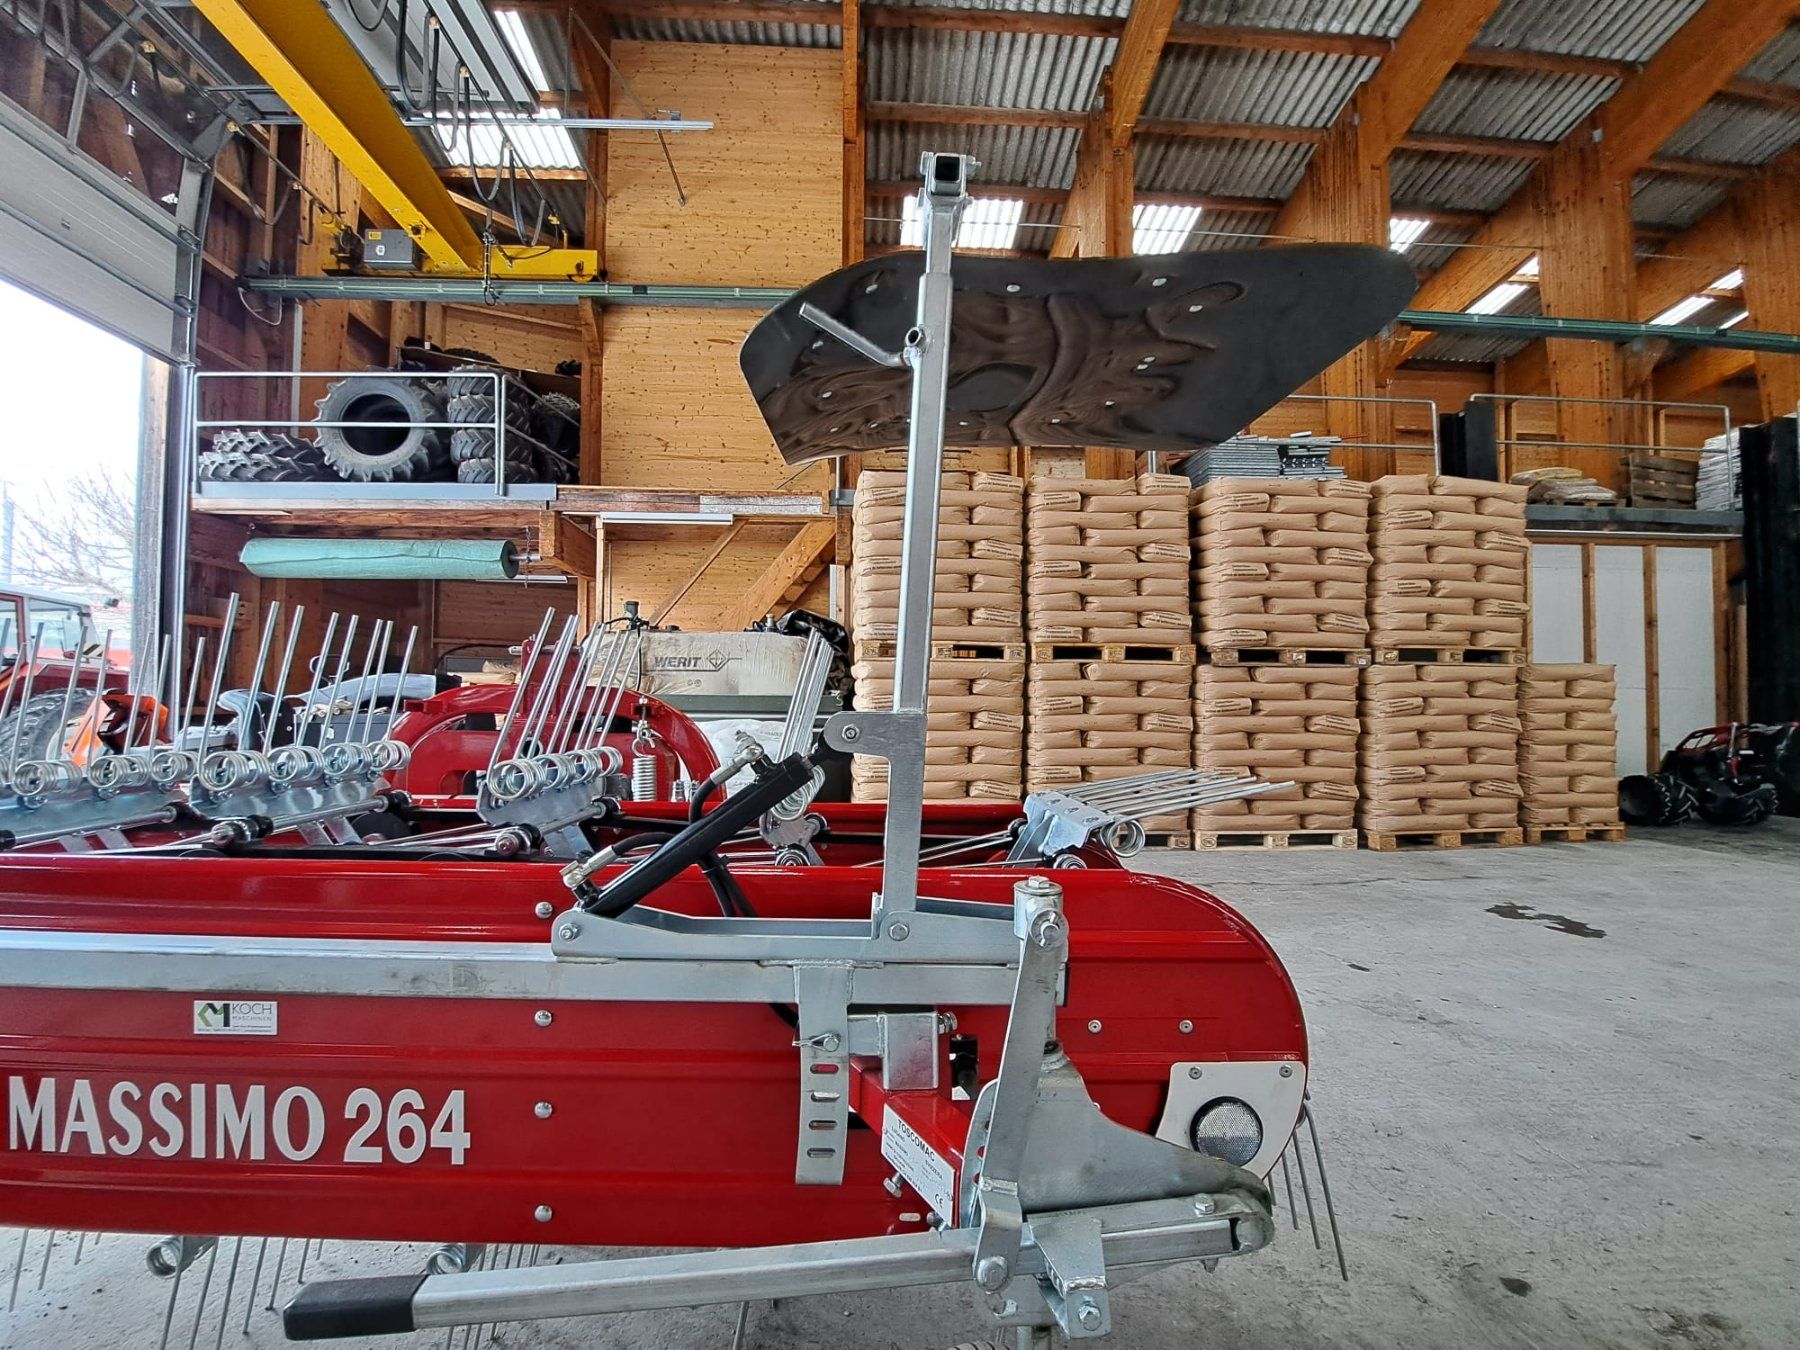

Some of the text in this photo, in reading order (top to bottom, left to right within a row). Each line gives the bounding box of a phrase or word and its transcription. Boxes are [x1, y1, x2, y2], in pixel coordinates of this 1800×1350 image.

[655, 657, 701, 667] WERIT
[232, 1003, 272, 1015] KOCH
[9, 1076, 471, 1165] MASSIMO 264
[897, 1119, 936, 1162] TOSCOMAC
[934, 1193, 944, 1209] CE
